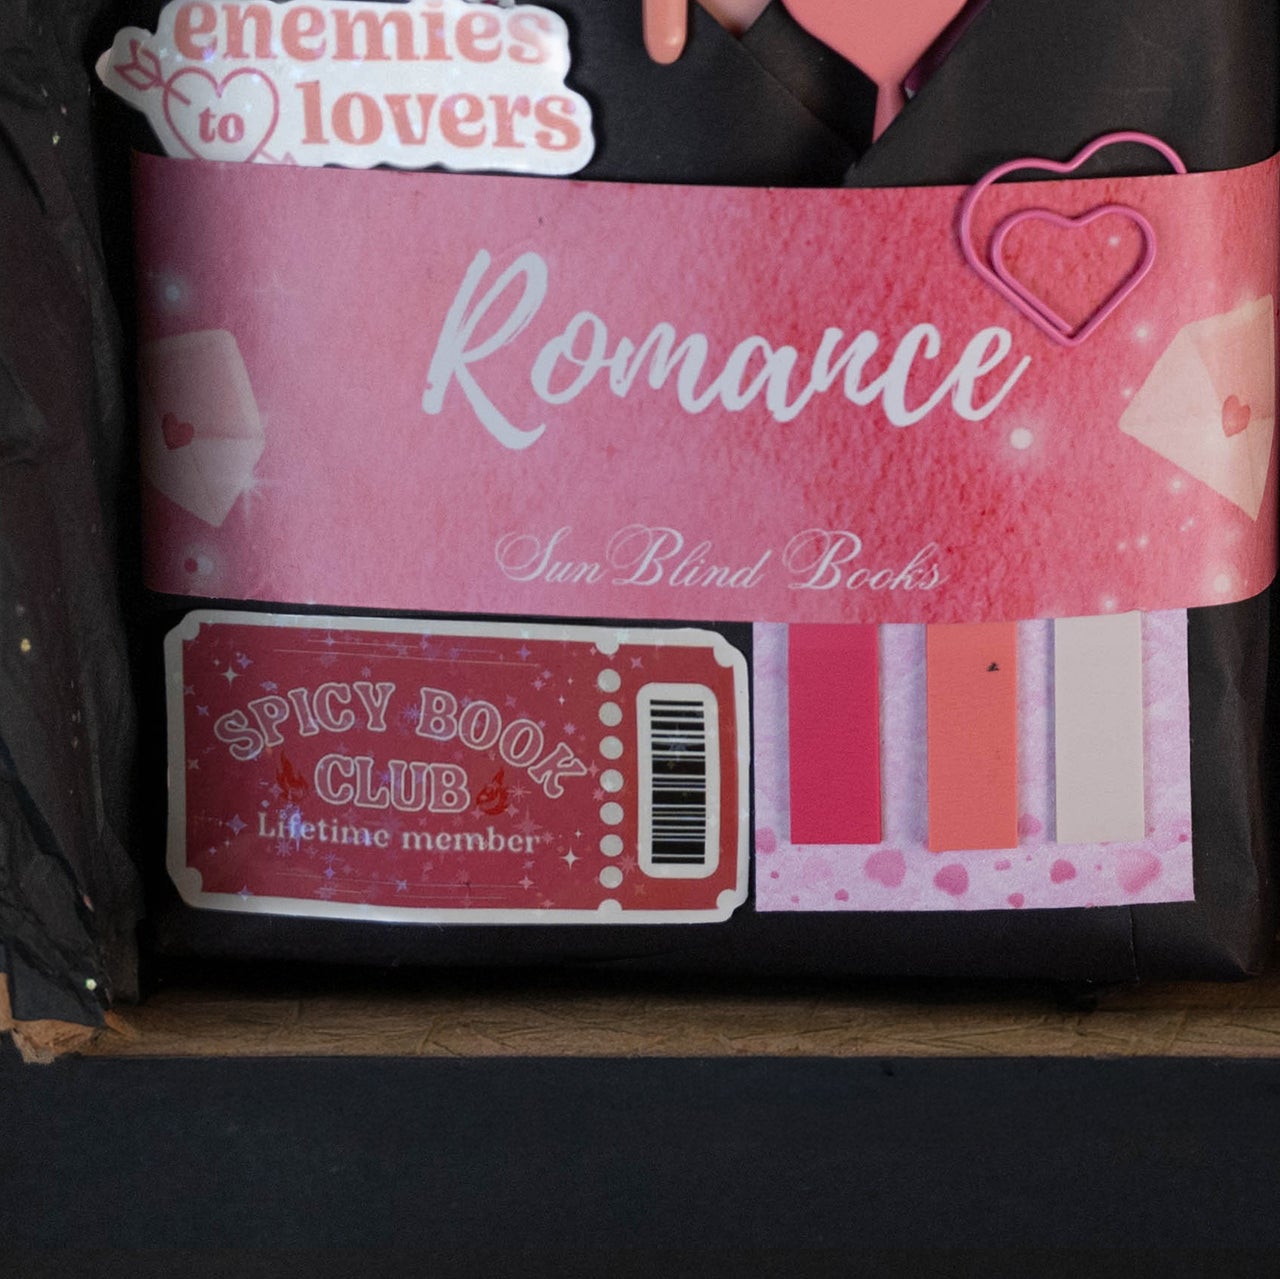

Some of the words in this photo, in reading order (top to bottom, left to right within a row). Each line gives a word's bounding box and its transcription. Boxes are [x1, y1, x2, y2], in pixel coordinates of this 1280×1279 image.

[199, 106, 246, 143] to
[295, 81, 581, 151] lovers
[422, 248, 1031, 450] Romance
[782, 528, 949, 591] Books
[214, 681, 396, 760] SPICY
[415, 686, 587, 799] BOOK
[315, 753, 470, 813] CLUB
[257, 812, 390, 847] Lifetime
[402, 827, 541, 853] member
